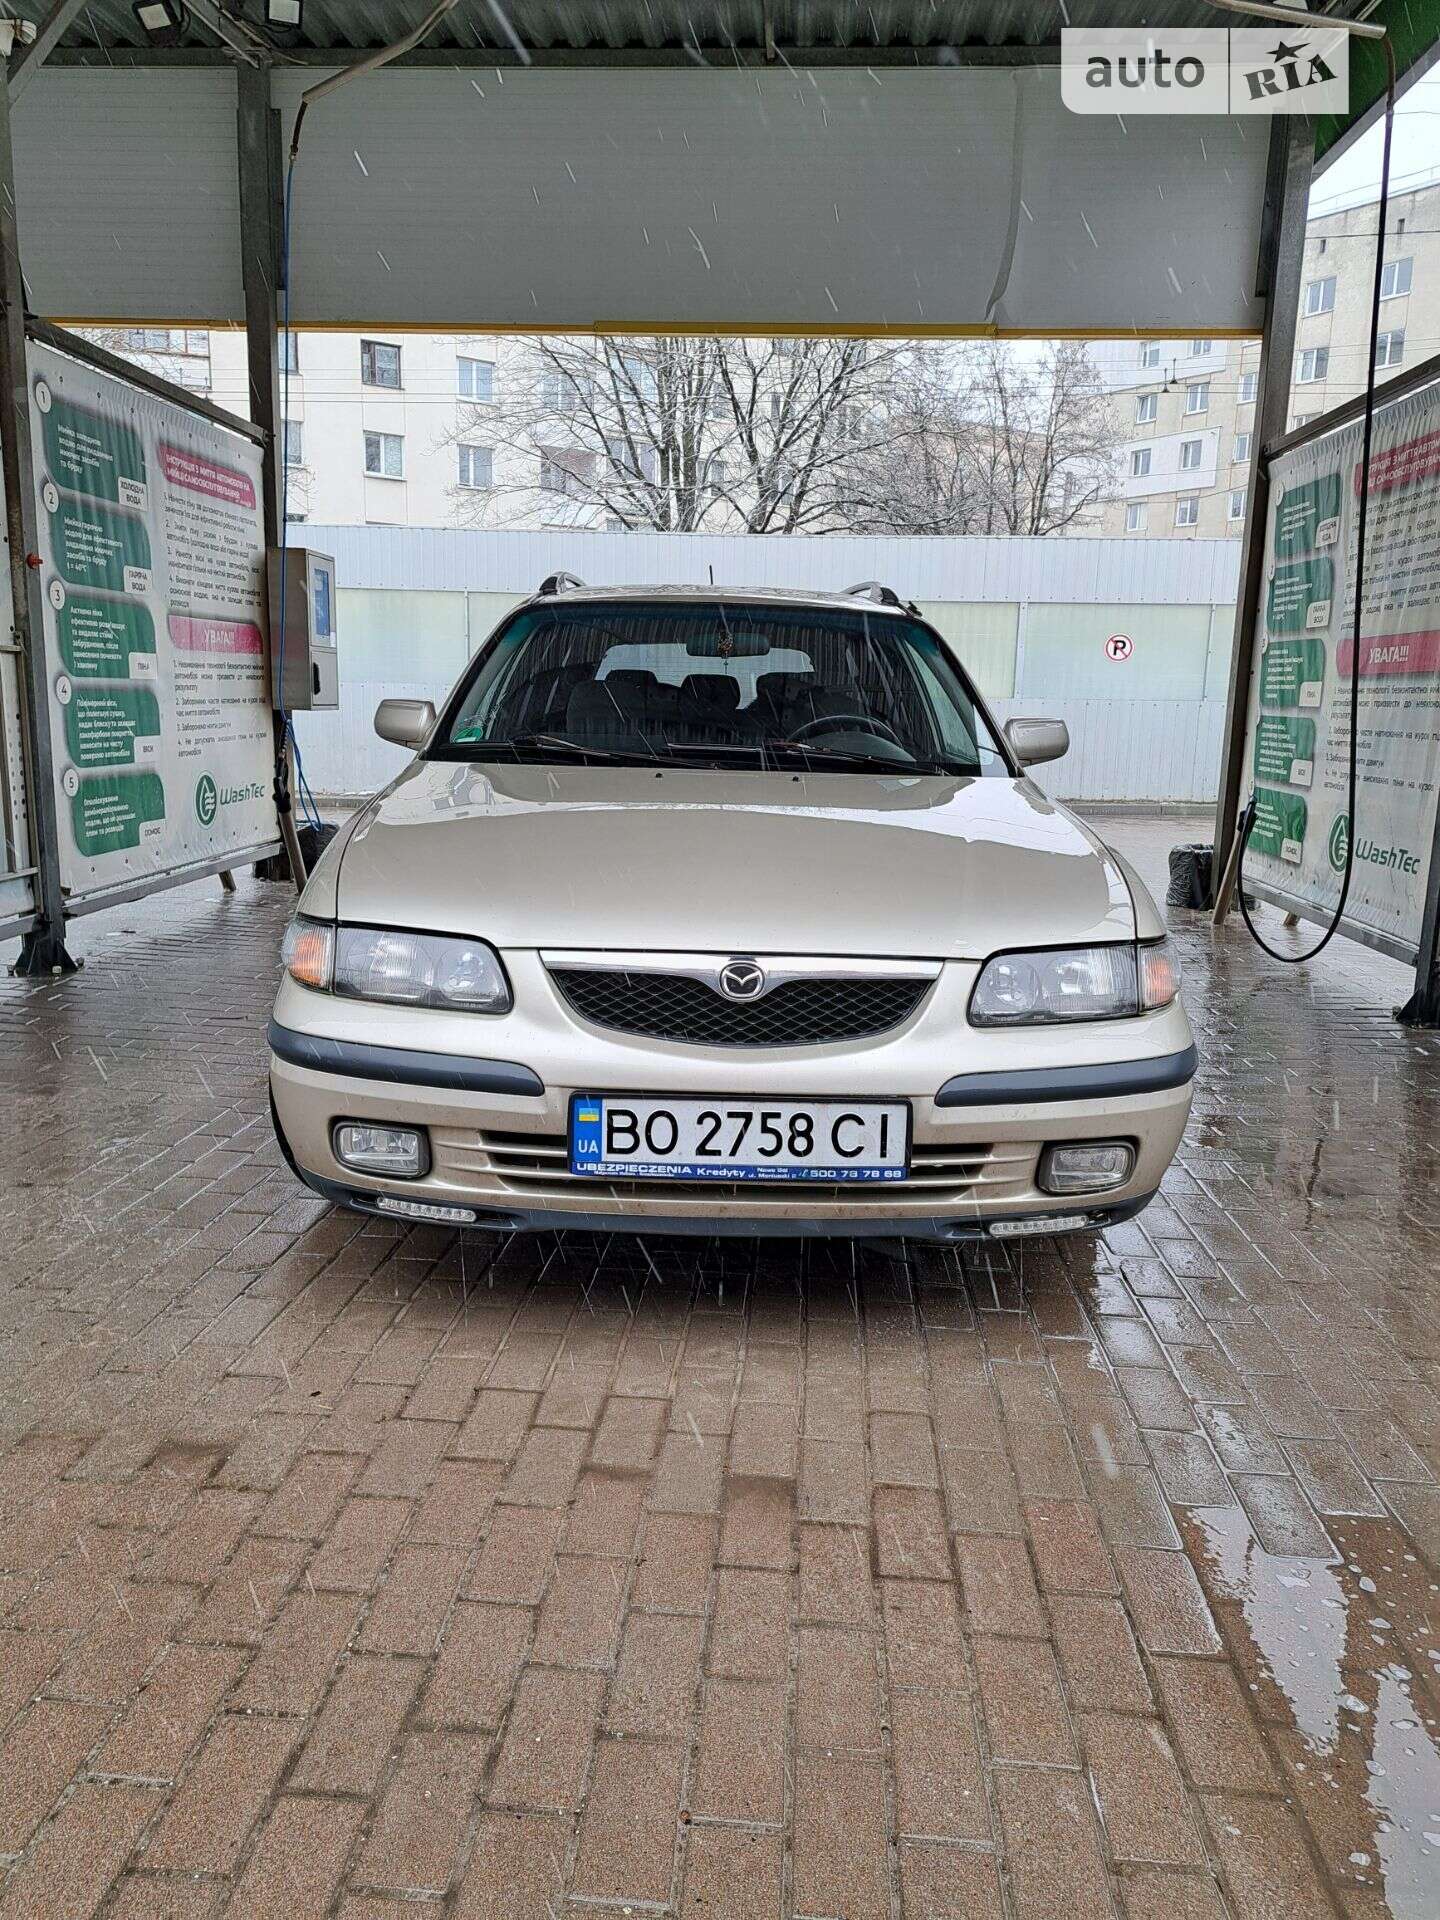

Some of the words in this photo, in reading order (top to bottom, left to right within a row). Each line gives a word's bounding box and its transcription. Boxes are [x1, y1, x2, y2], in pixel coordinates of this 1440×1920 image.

[126, 496, 142, 505] ВОДА
[132, 582, 146, 591] ВОДА
[1369, 645, 1410, 664] УВАГА!!!
[220, 783, 266, 806] WashTec
[1355, 837, 1422, 875] WashTec
[606, 1108, 679, 1155] BO
[695, 1110, 815, 1159] 2758
[830, 1113, 888, 1159] CI
[578, 1140, 599, 1154] UA
[576, 1162, 692, 1174] UBEZPIECZENIA
[697, 1168, 746, 1178] Kredyty
